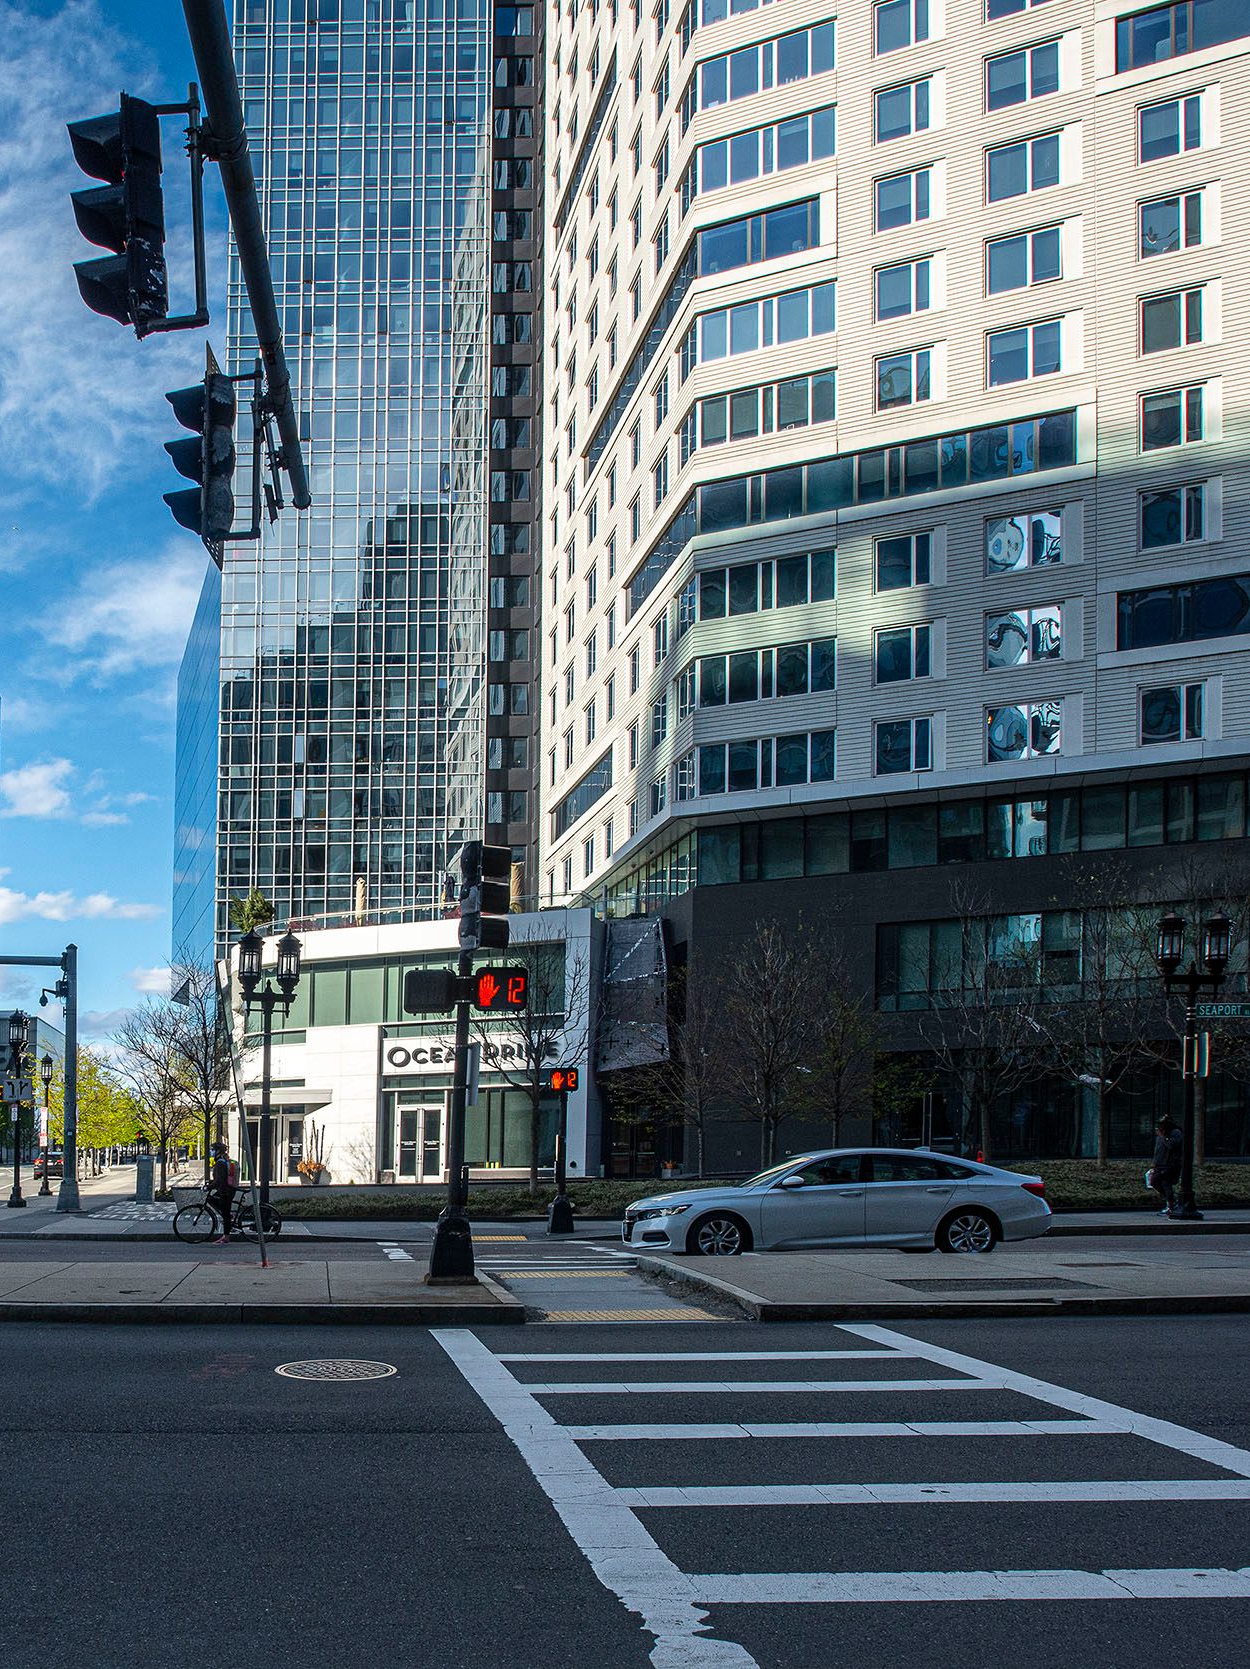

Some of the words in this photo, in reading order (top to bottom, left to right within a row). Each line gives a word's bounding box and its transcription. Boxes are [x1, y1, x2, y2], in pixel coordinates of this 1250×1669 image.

[507, 977, 525, 1003] 12
[1199, 1005, 1242, 1015] SEAPORT
[387, 1046, 456, 1067] OCEA
[482, 1041, 559, 1061] DRIE
[567, 1072, 576, 1087] 12
